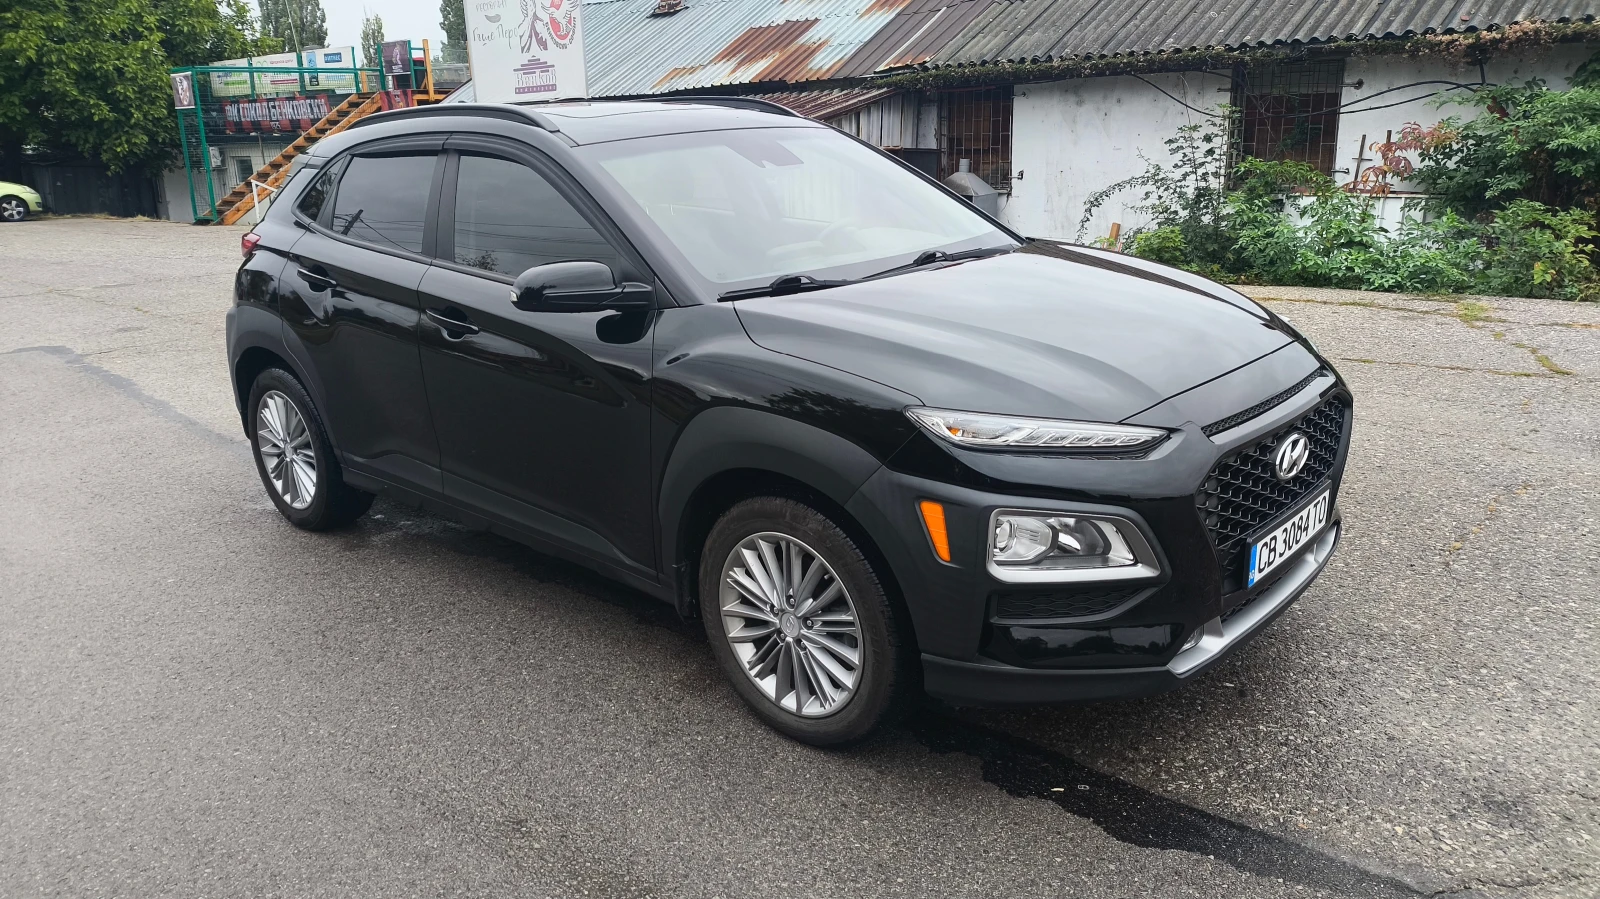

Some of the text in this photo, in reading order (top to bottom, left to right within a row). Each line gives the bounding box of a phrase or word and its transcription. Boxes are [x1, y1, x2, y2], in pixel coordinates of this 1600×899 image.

[225, 98, 328, 122] ФК СОКОЛ БЕНКОВСКИ
[1279, 509, 1310, 557] 3084
